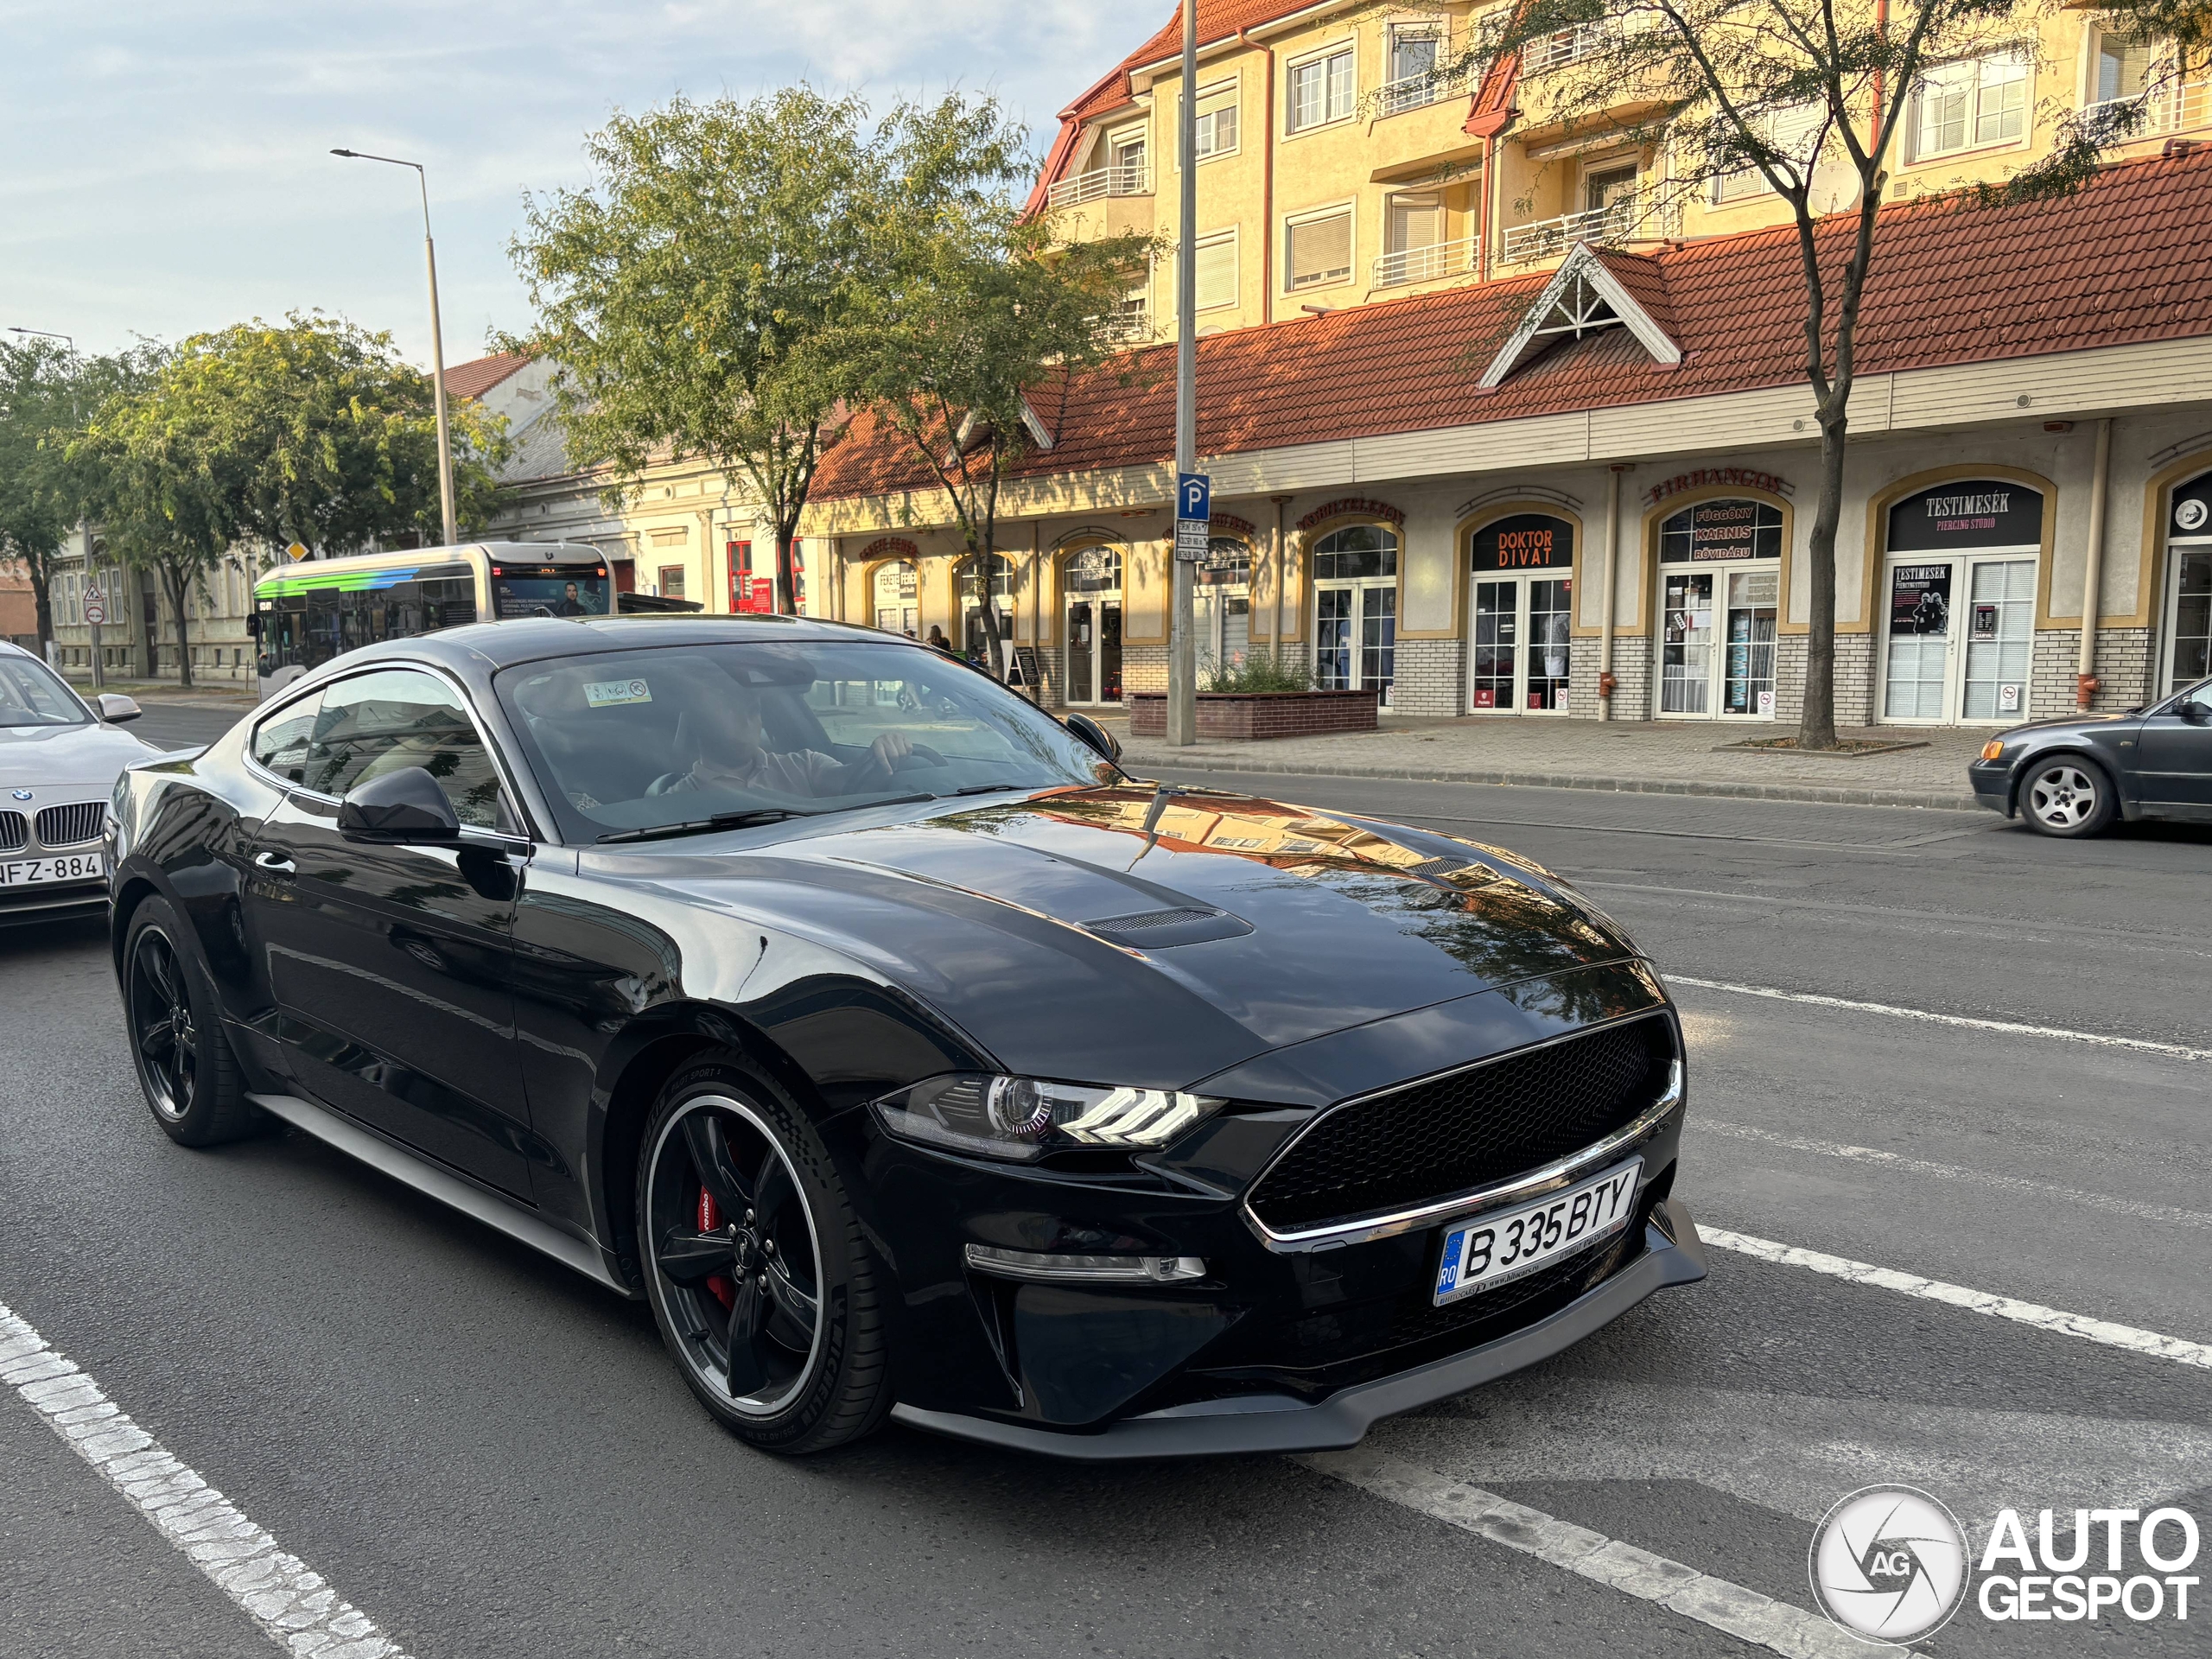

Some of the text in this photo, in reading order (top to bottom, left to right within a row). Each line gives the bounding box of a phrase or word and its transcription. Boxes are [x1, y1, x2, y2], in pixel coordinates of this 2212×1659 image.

[1188, 486, 1202, 513] P
[1926, 489, 2011, 518] TESTIMESÉK
[1696, 506, 1753, 522] FÜGGÖNY
[1936, 516, 1995, 531] PIERCING STÚDIÓ
[1498, 530, 1553, 550] DOKTOR
[1694, 525, 1752, 542] KARNIS
[1498, 547, 1552, 567] DIVAT
[1694, 545, 1751, 560] RÖVIDÁRU
[1896, 565, 1946, 580] TESTIMESÉK
[690, 1068, 715, 1080] SPORT
[1464, 1172, 1630, 1280] B 335 BTY
[1439, 1264, 1457, 1287] RO
[799, 1324, 843, 1427] MICHELIN
